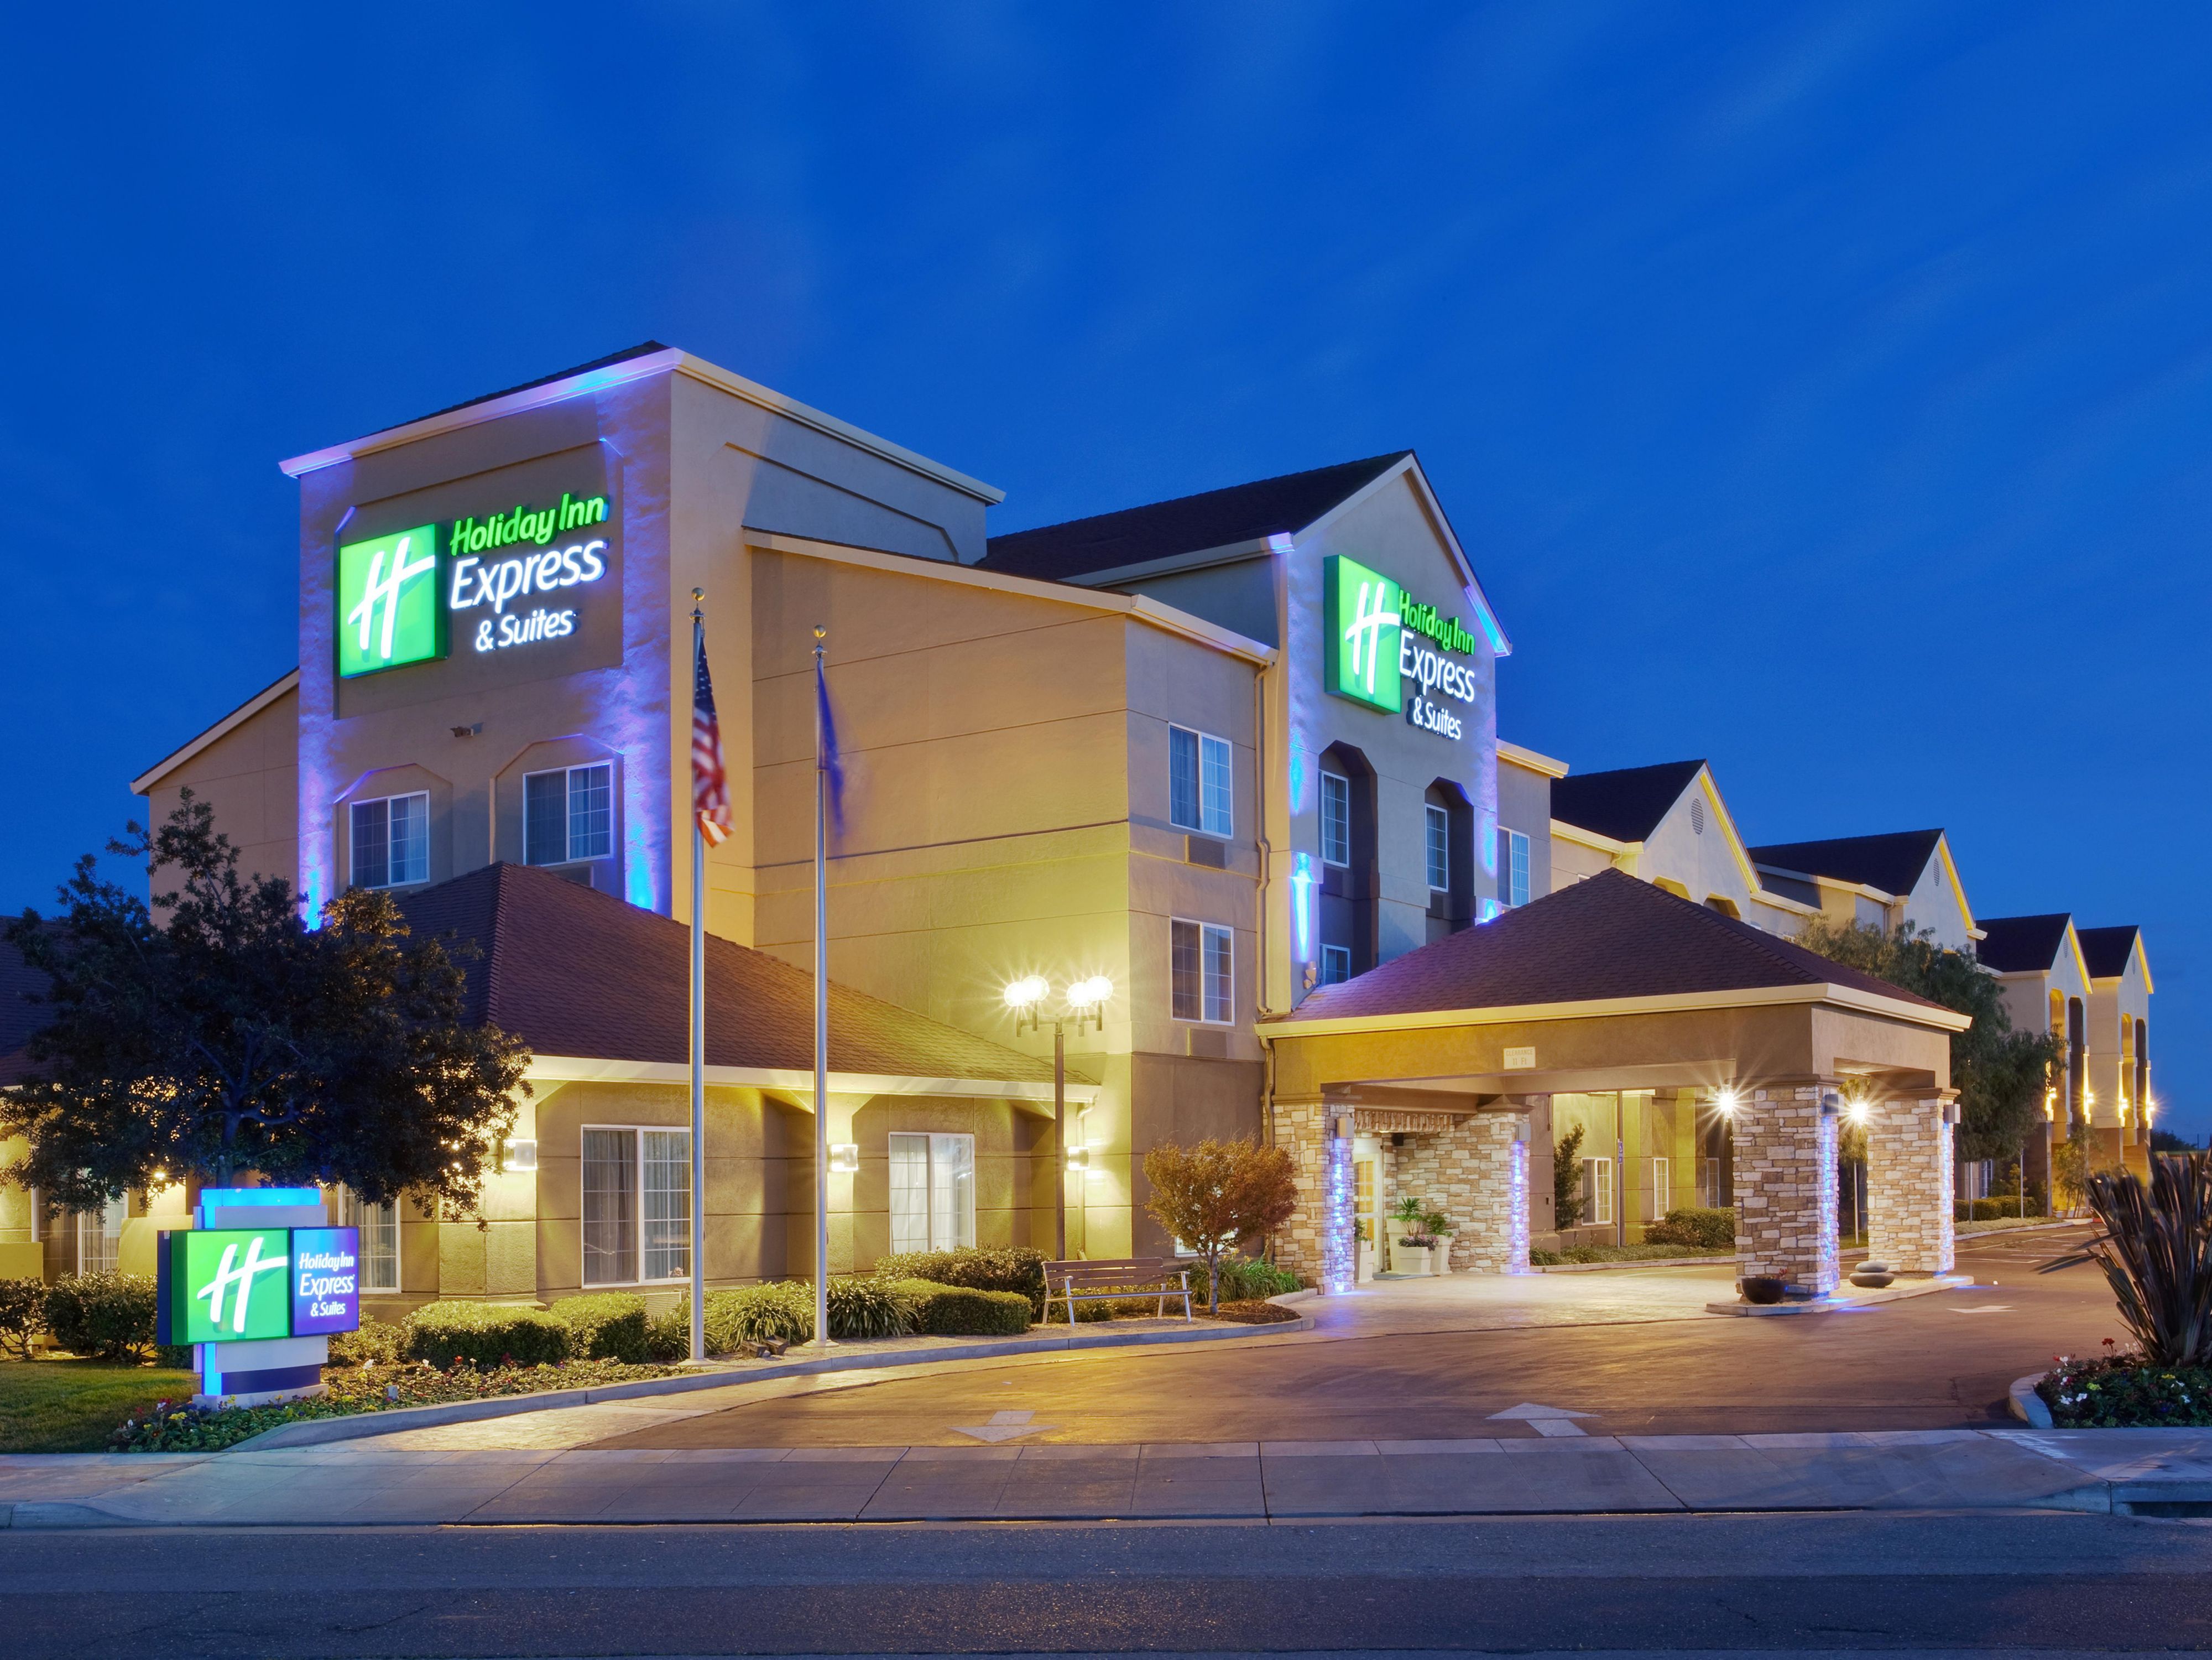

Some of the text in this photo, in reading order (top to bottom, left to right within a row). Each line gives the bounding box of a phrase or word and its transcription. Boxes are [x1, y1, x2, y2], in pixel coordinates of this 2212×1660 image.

[450, 492, 605, 555] Holiday Inn
[450, 540, 606, 613] Express
[475, 610, 573, 652] & Suites
[1400, 589, 1475, 655] Holiday Inn
[1400, 629, 1475, 702] Express
[1413, 697, 1462, 740] & Suites
[1512, 1058, 1517, 1066] 11
[299, 1251, 354, 1272] Holiday Inn
[299, 1273, 354, 1301] Express
[310, 1301, 346, 1316] & Suites
